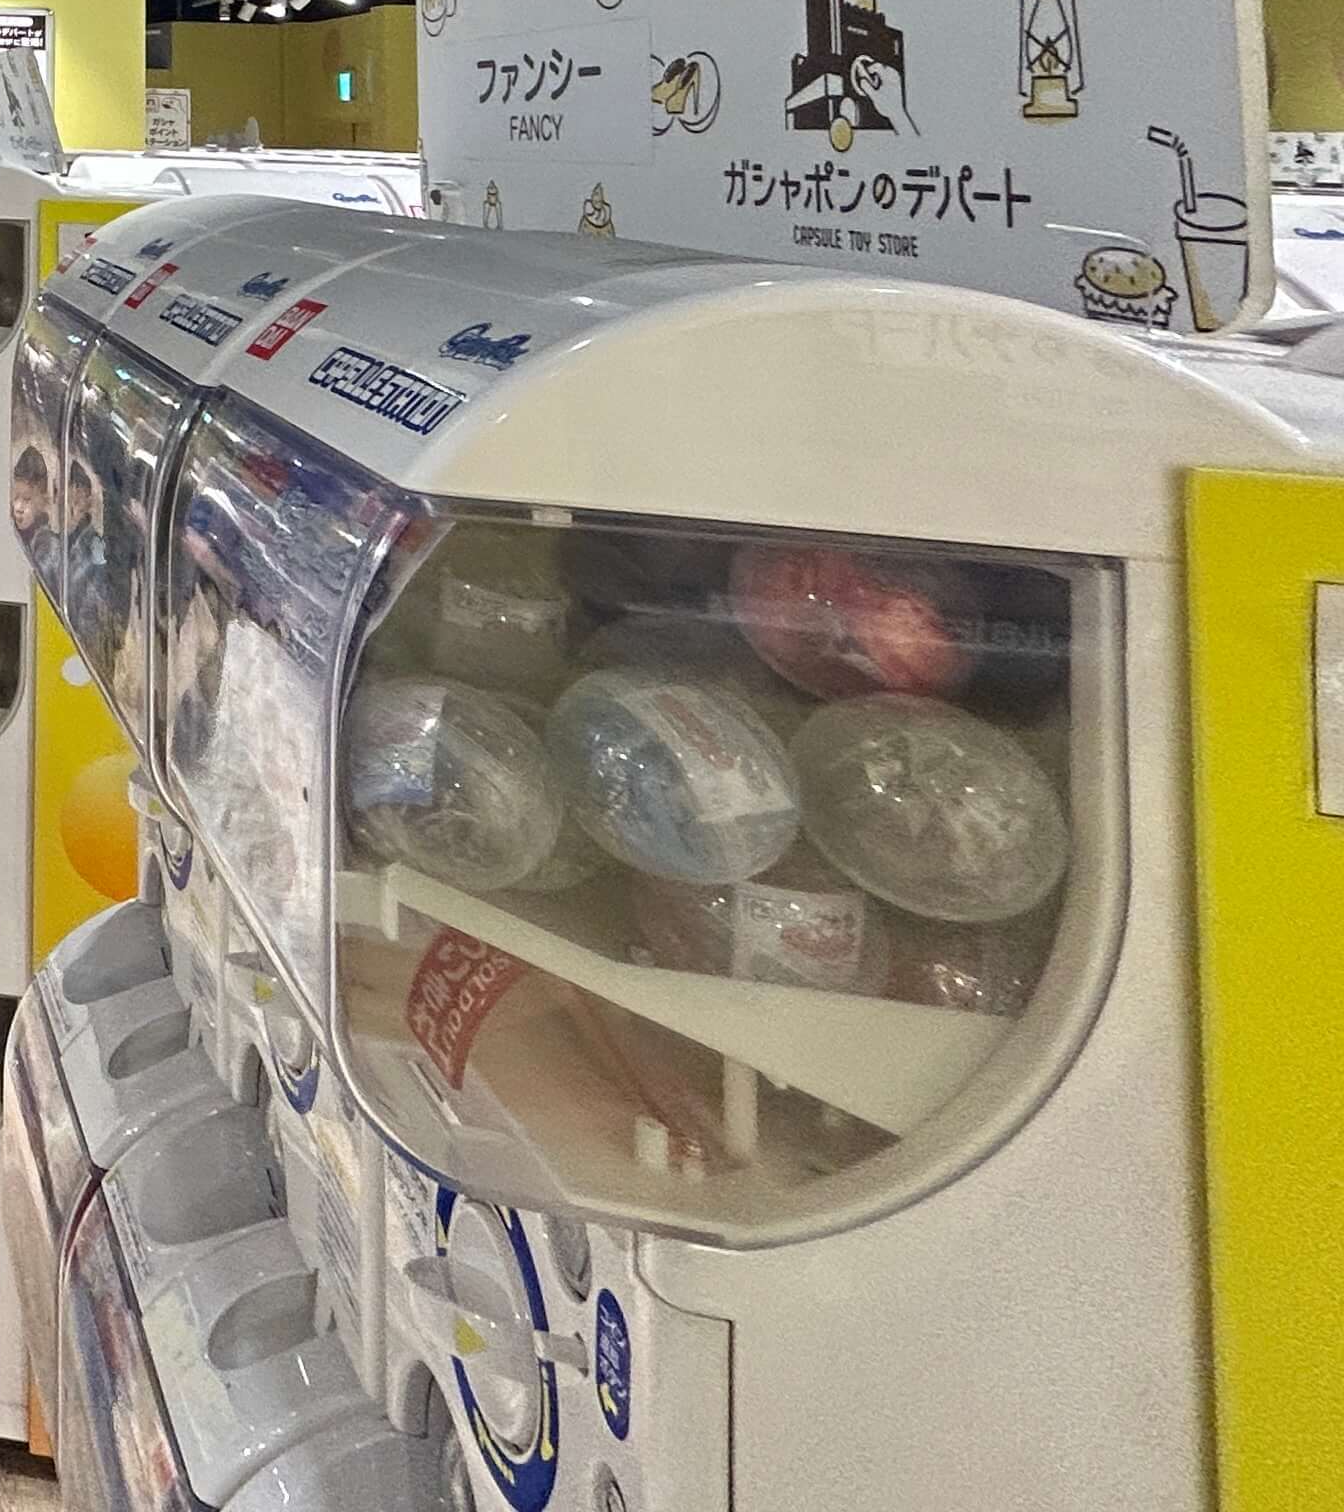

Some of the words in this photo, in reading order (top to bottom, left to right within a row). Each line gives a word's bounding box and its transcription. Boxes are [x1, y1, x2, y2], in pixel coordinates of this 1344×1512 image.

[475, 48, 603, 104] ファンシー
[509, 115, 563, 142] FANCY
[724, 159, 1032, 229] ガシャポンのデパート
[793, 225, 842, 250] CAPSULE
[847, 230, 872, 251] TOY
[878, 233, 919, 257] STORE
